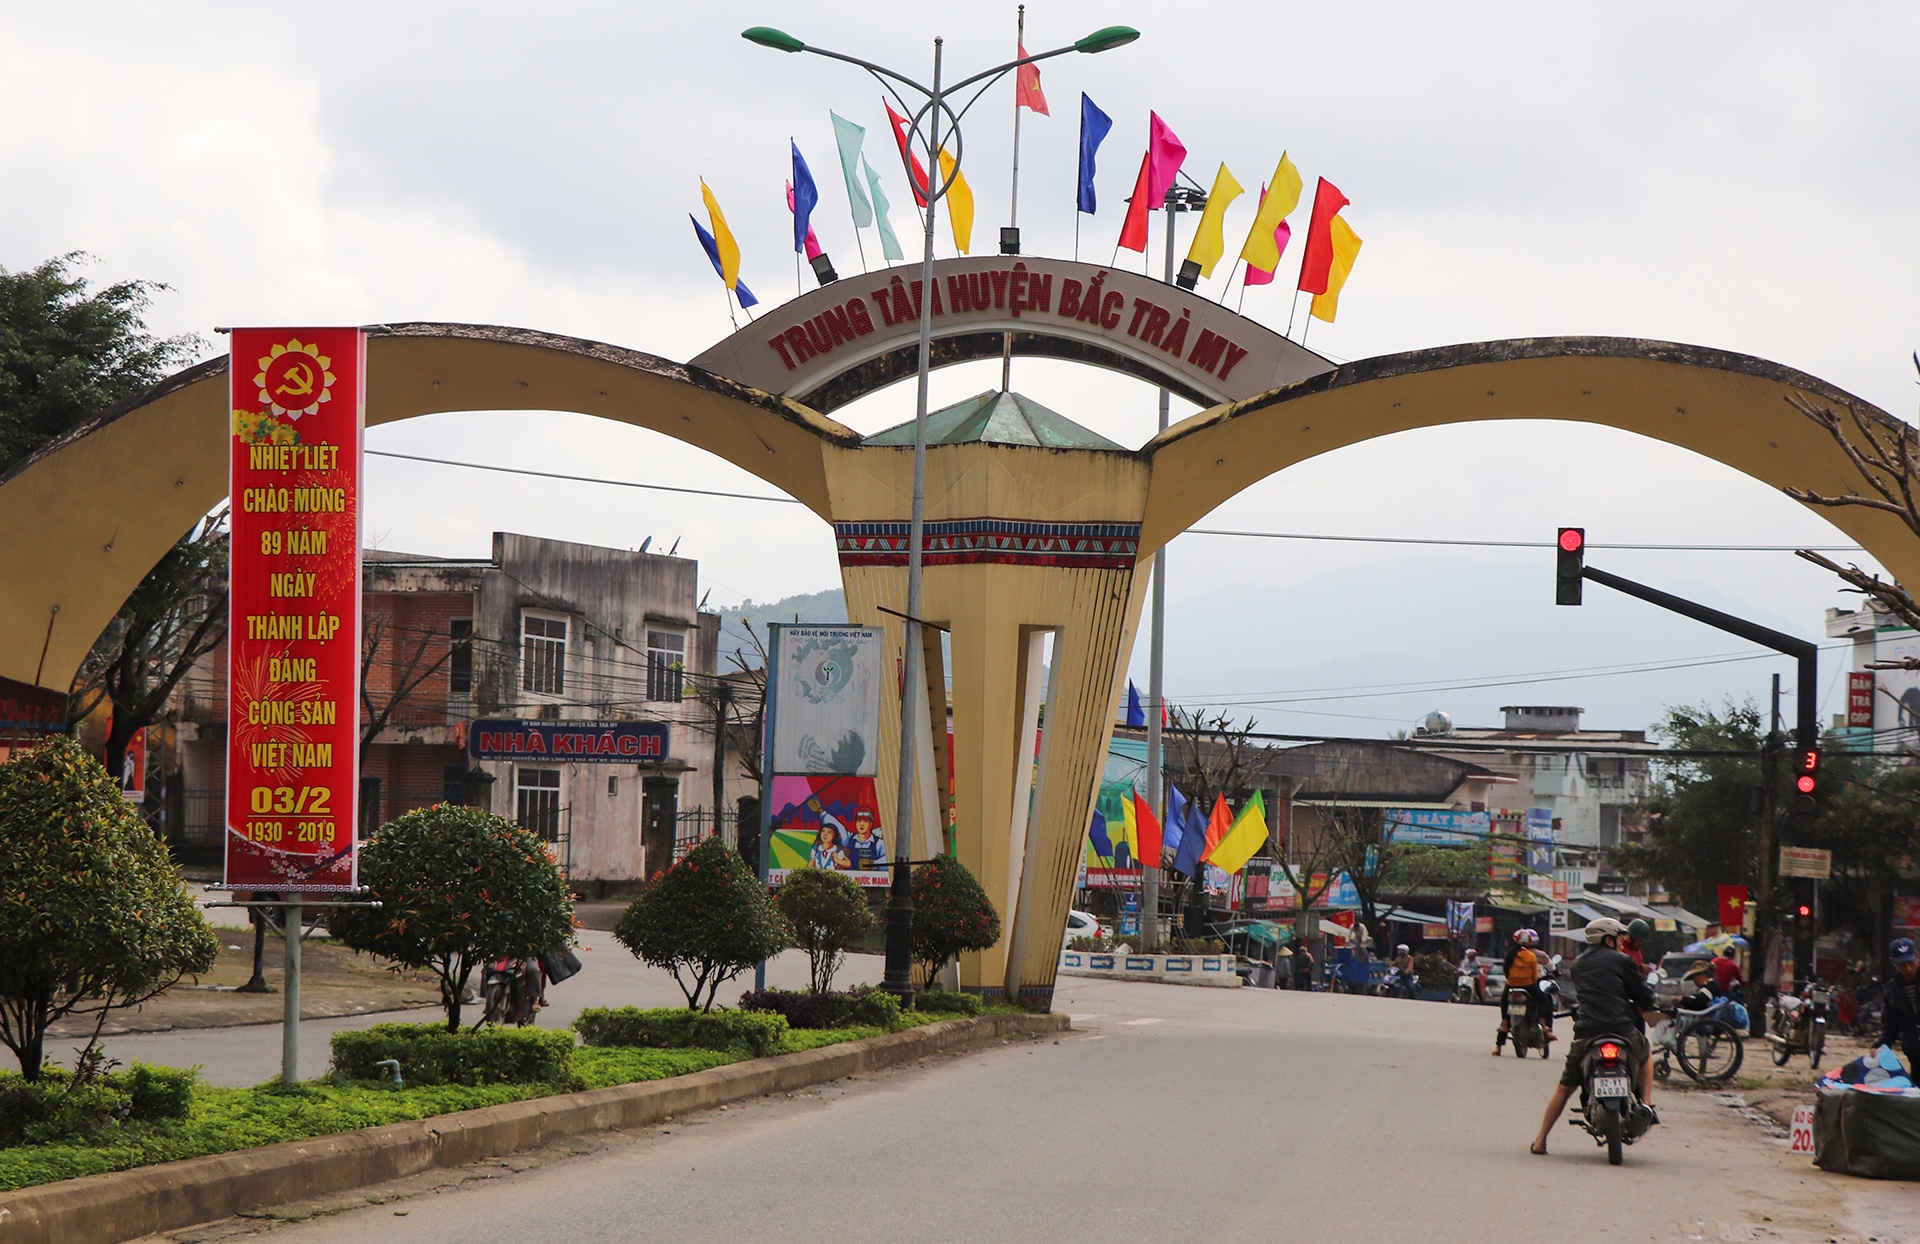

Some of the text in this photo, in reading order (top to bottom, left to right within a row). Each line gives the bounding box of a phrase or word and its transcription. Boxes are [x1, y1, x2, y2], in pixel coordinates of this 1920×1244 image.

[768, 301, 874, 371] TRUNG
[947, 261, 1052, 317] HUYỆN
[1057, 274, 1124, 330] BẮC
[1126, 298, 1194, 360] TRÀ
[1188, 328, 1249, 382] MY
[249, 440, 339, 476] NHIỆT LIỆT
[243, 482, 345, 513] CHÀO MỪNG
[261, 526, 327, 555] 89 NĂM
[270, 568, 317, 598] NGÀY
[247, 610, 340, 645] THÀNH LẬP
[269, 651, 316, 683] ĐẢNG
[248, 692, 336, 730] CỘNG SẢN
[251, 739, 332, 773] VIỆT NAM
[480, 728, 661, 756] NHÀ KHÁCH
[1805, 752, 1817, 769] 3
[250, 786, 332, 814] 03/2
[246, 822, 283, 842] 1930
[297, 822, 336, 842] 2019
